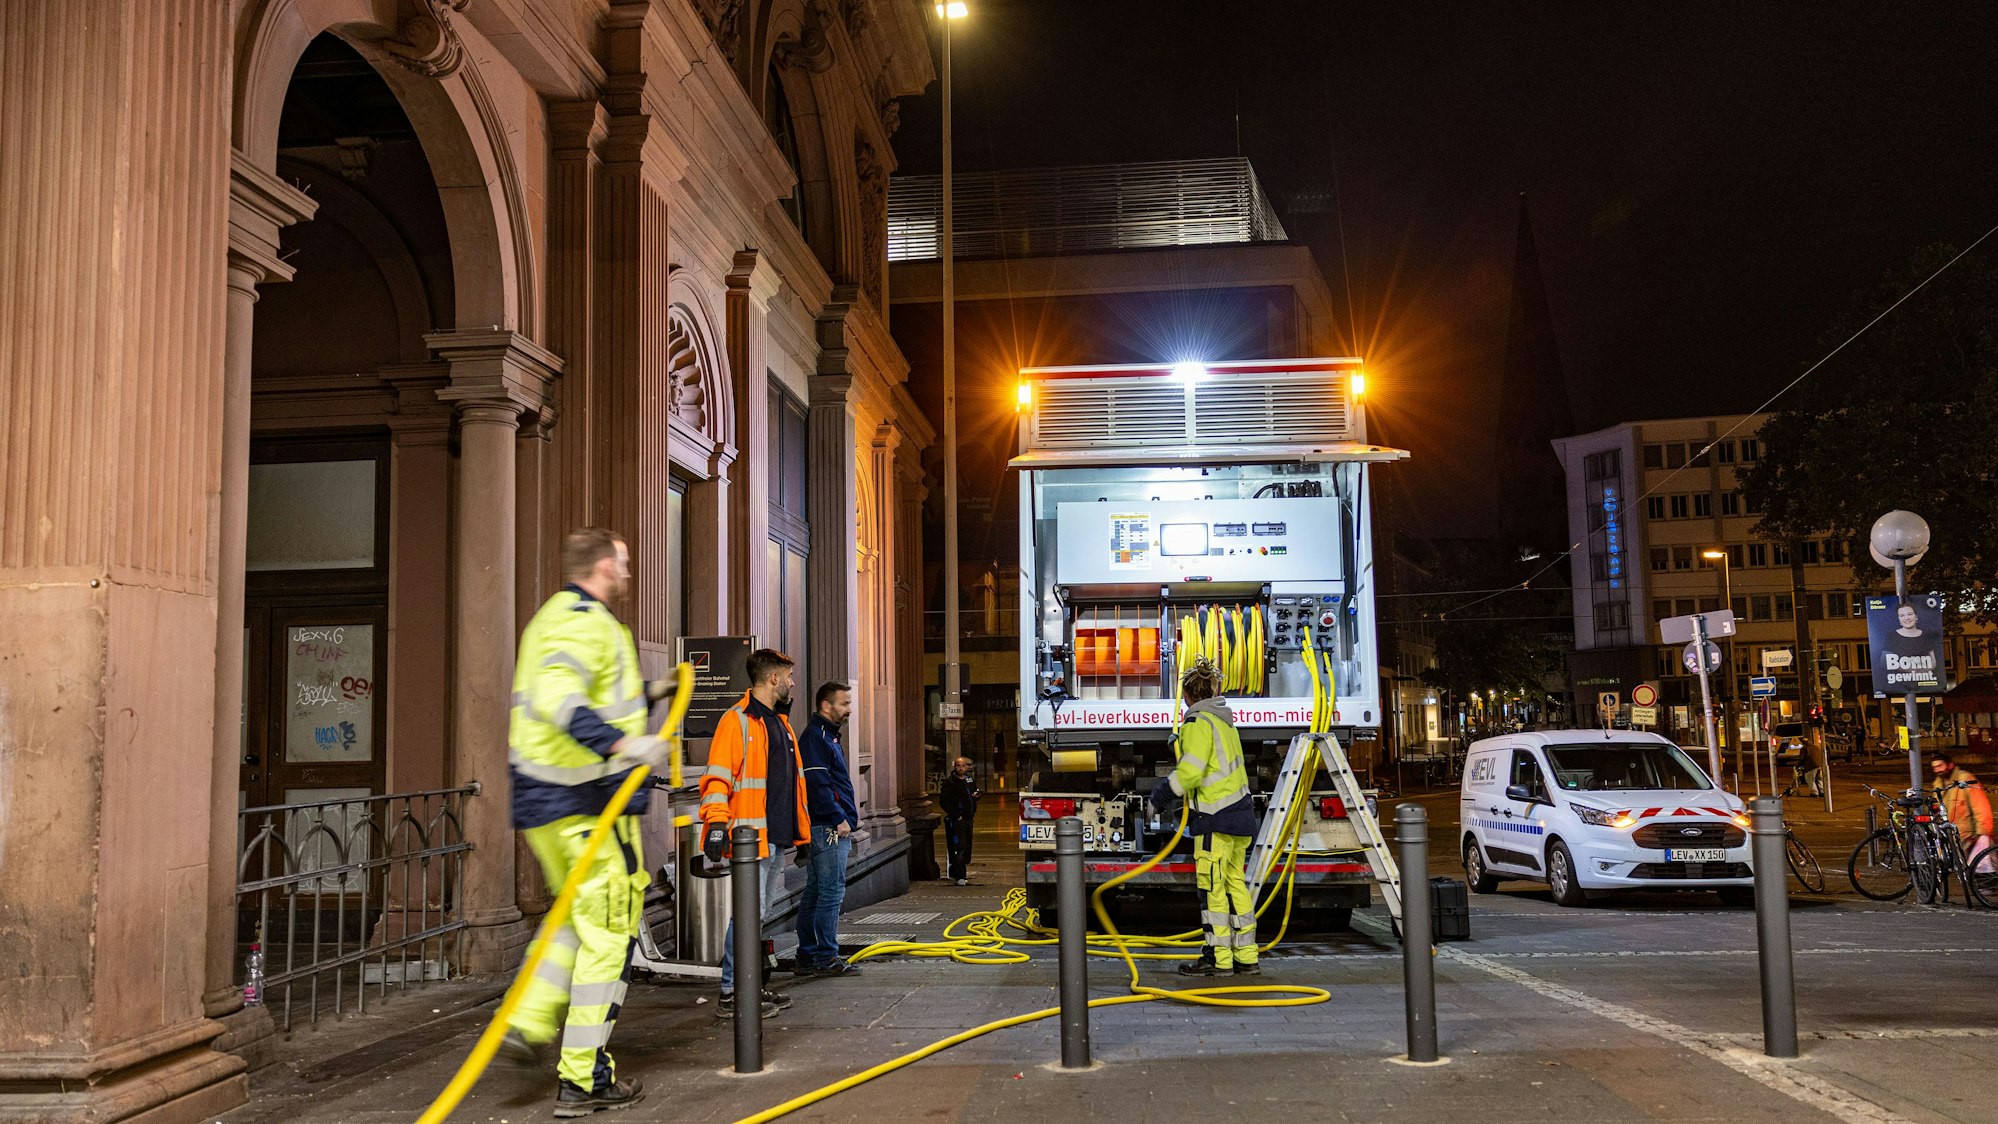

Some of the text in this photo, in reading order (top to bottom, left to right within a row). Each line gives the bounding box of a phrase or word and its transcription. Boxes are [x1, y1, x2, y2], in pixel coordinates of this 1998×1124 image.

[1885, 653, 1932, 670] Bonn
[1887, 670, 1937, 684] gewinnt.
[1232, 707, 1341, 723] strom-mien
[1028, 826, 1052, 838] LEV
[1671, 849, 1724, 860] LEV XX 150
